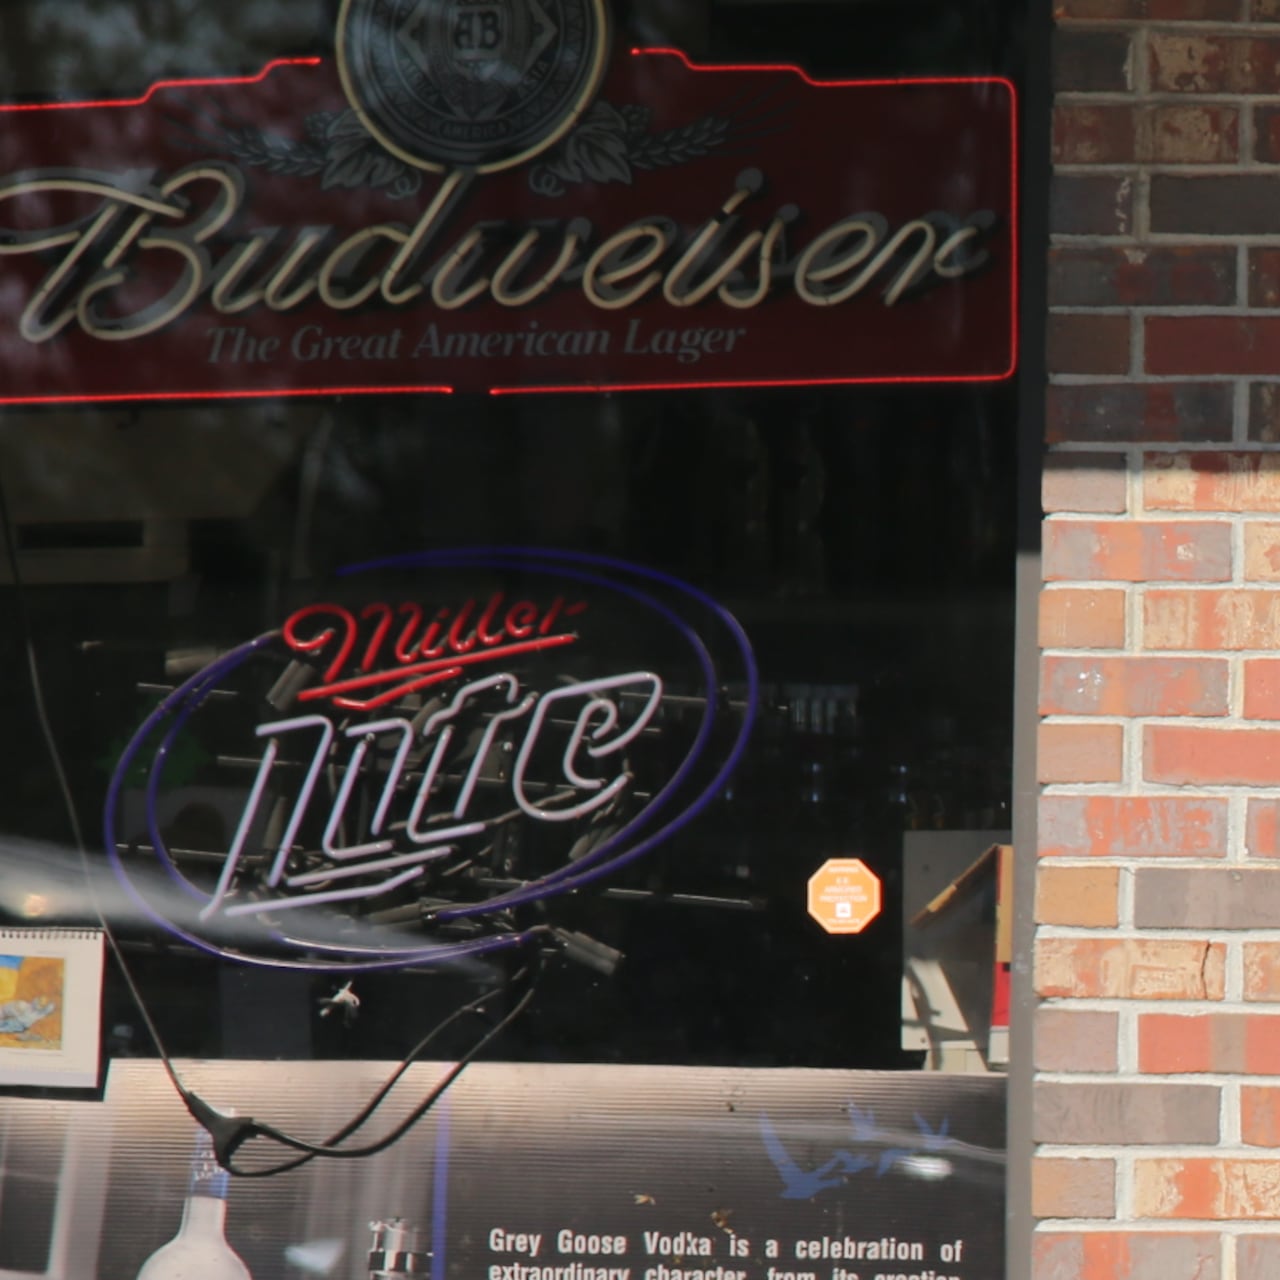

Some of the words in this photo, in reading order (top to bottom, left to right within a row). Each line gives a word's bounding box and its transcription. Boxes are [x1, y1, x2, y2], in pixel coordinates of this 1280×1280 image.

[0, 165, 995, 342] Budweiser
[206, 326, 280, 364] The
[291, 321, 402, 362] Great
[411, 319, 610, 360] American
[624, 318, 747, 364] Lager
[283, 591, 588, 683] Miller
[200, 671, 663, 919] Lite
[489, 1227, 542, 1258] Grey
[557, 1228, 627, 1255] Goose
[643, 1230, 713, 1257] Vodka
[729, 1232, 751, 1257] is
[765, 1239, 779, 1258] a
[795, 1236, 924, 1261] celebration
[940, 1239, 963, 1263] of
